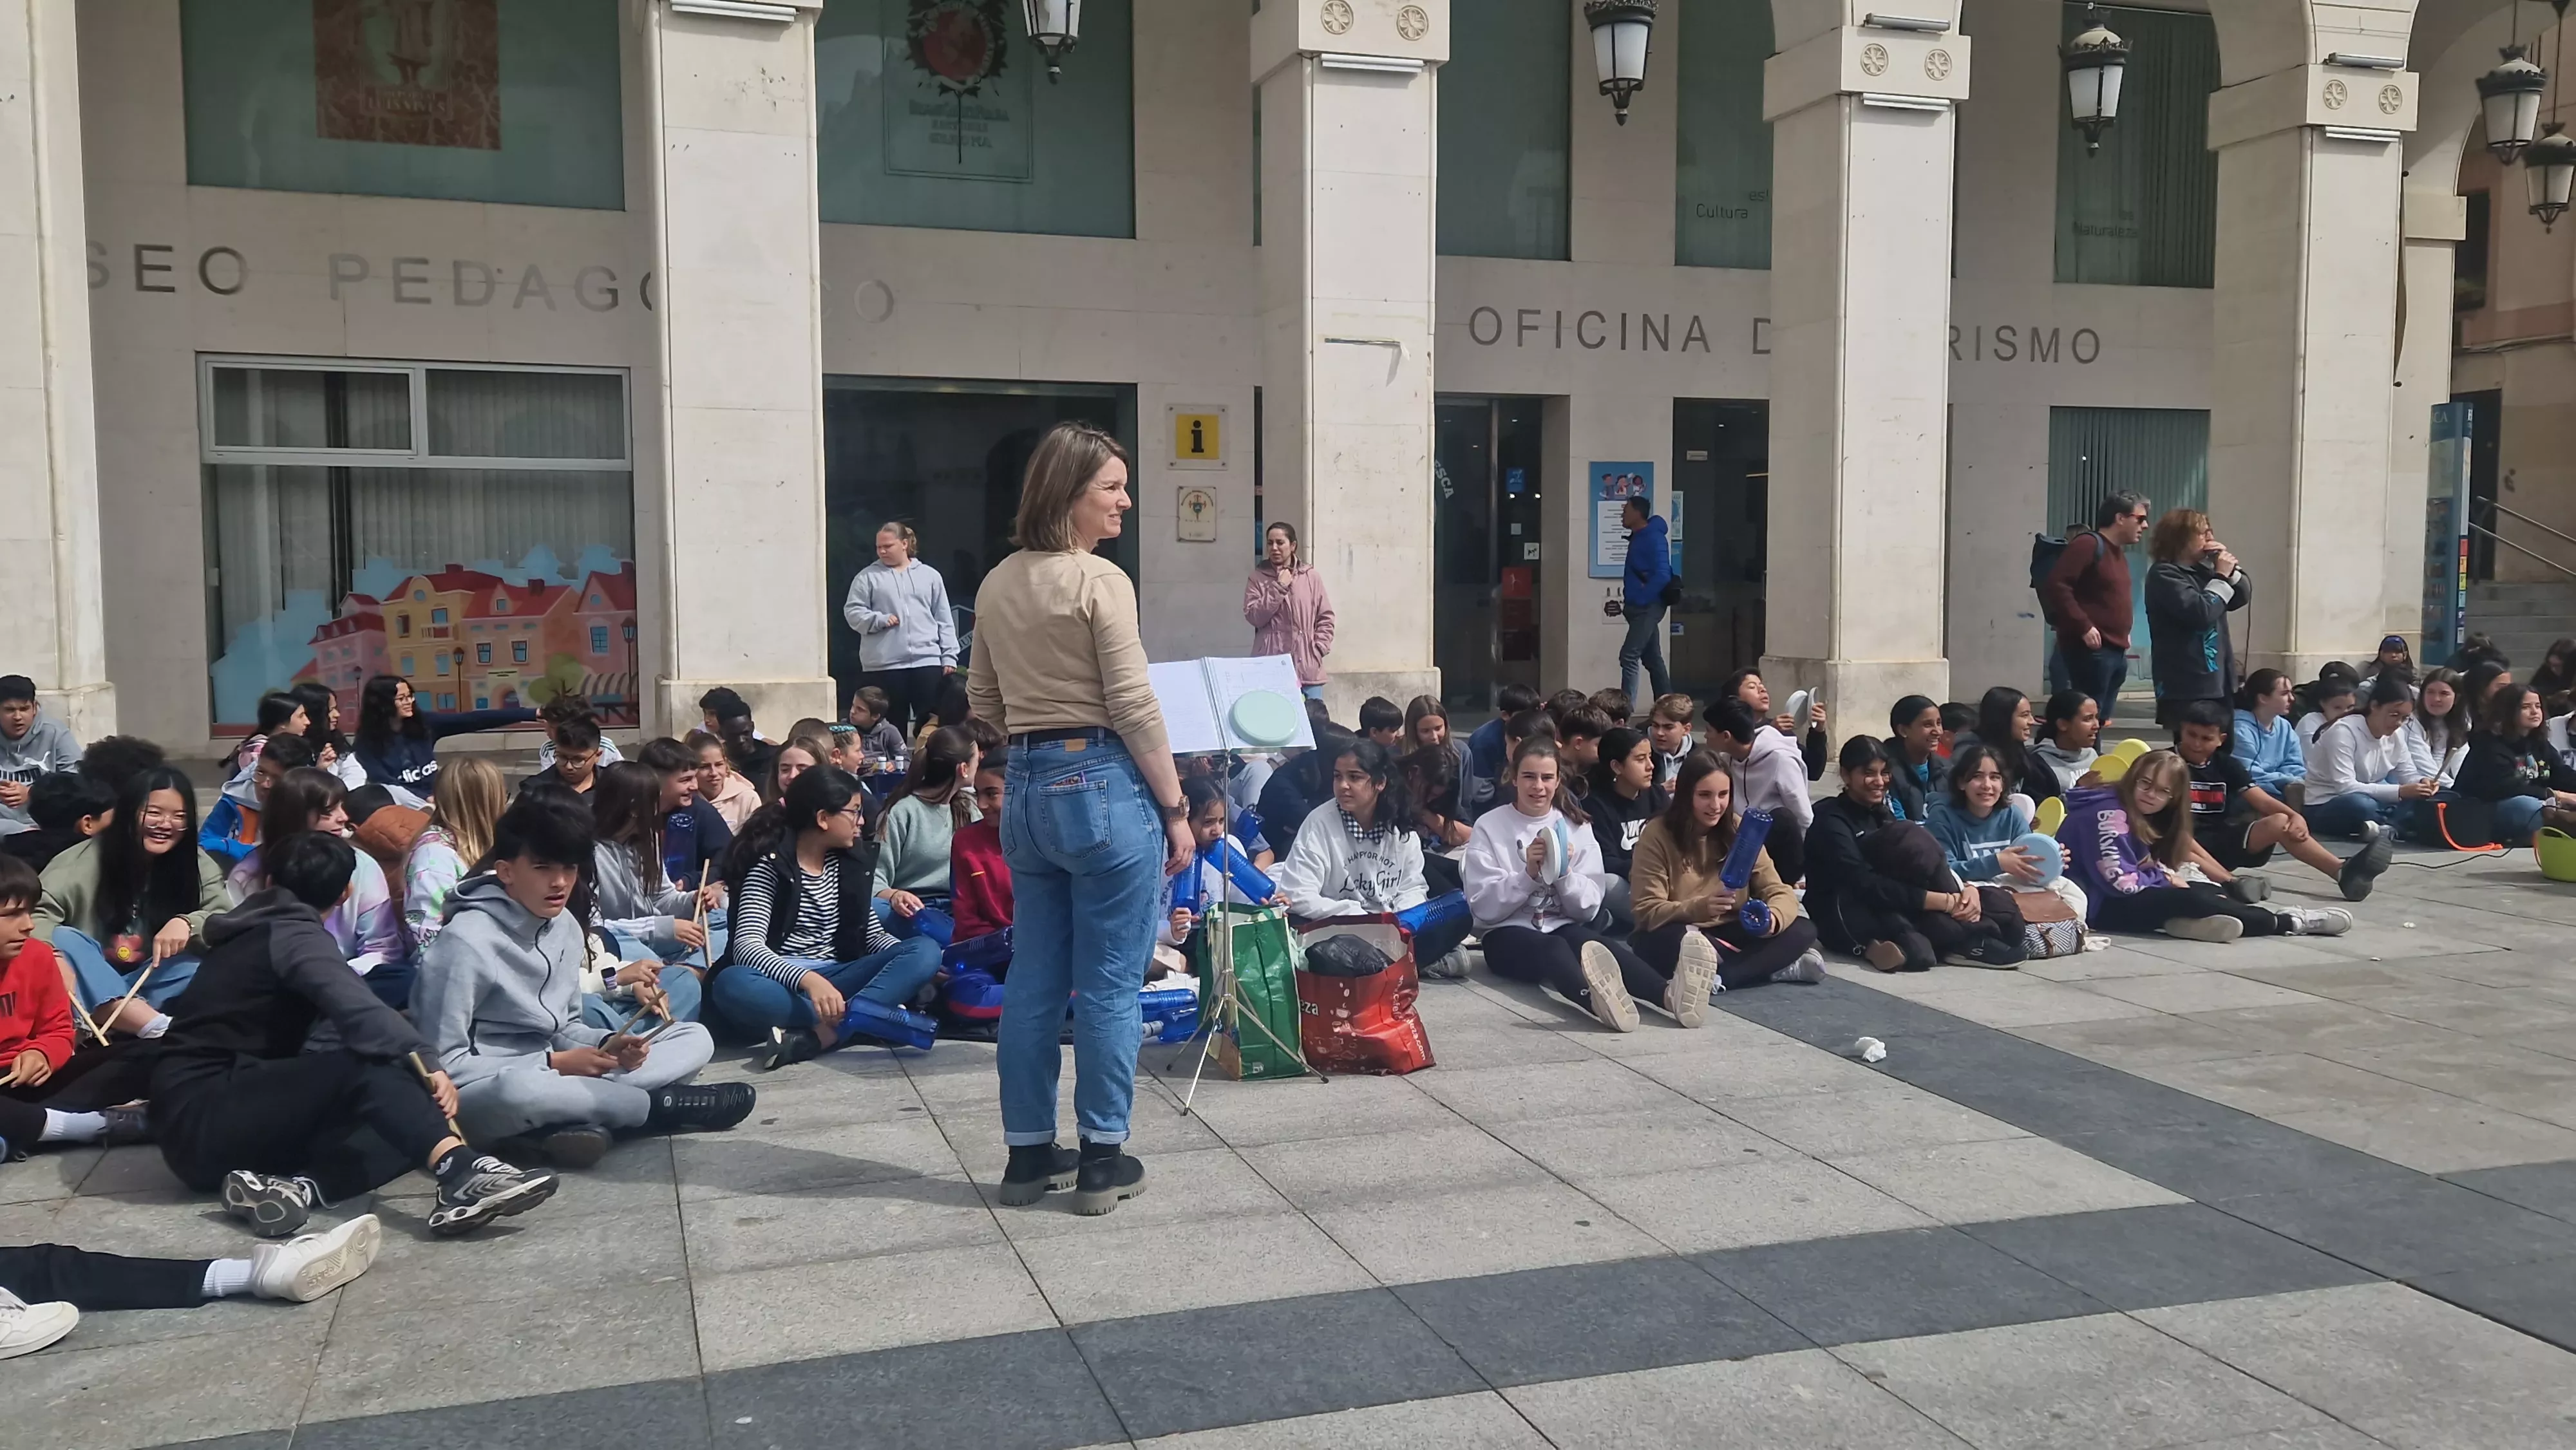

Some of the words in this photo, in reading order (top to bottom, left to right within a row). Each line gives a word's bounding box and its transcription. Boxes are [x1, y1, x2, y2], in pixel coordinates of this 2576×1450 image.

[1696, 203, 1748, 219] Cultura
[1468, 306, 1711, 354] OFICINA
[1949, 325, 2101, 364] RISMO
[1621, 818, 1648, 838] NIK
[1377, 868, 1402, 898] Girl
